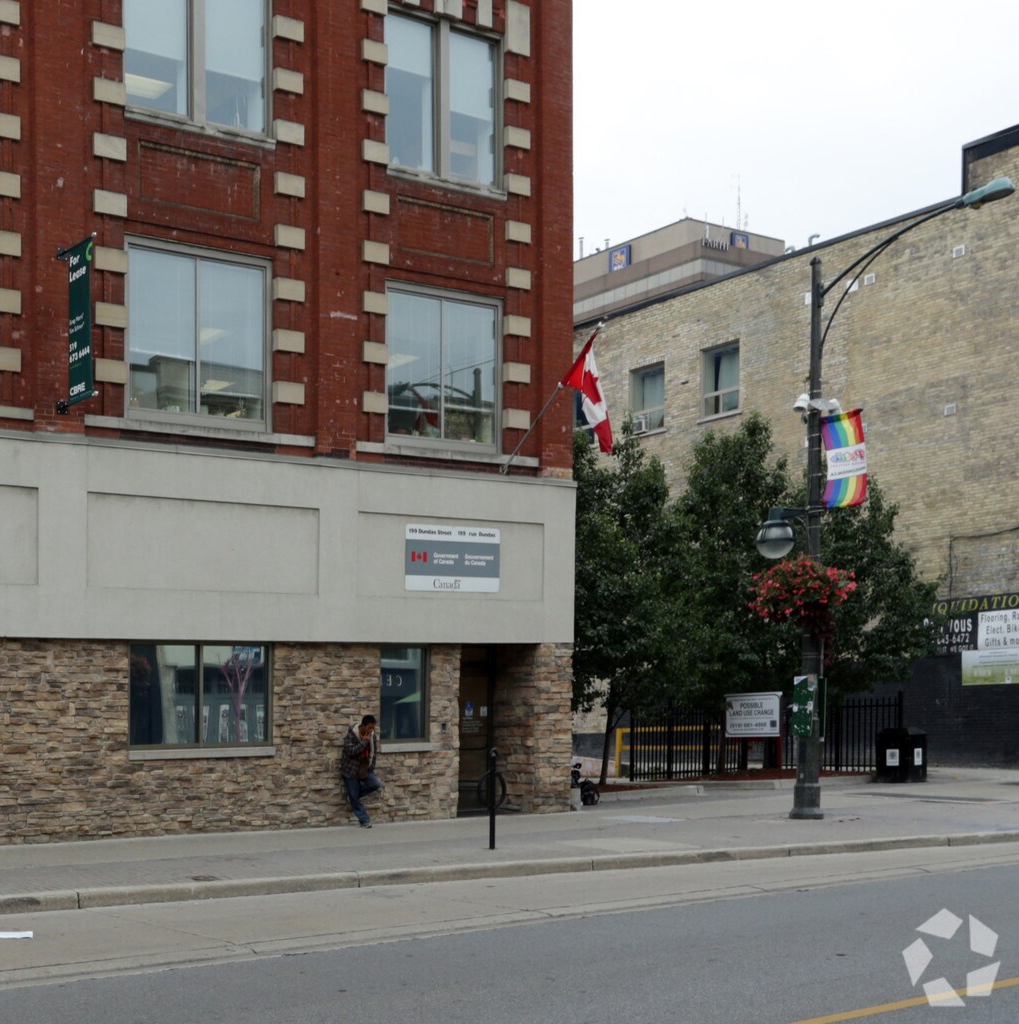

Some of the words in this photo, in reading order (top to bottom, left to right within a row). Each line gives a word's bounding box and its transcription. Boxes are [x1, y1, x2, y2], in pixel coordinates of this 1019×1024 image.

[69, 254, 81, 268] For
[69, 265, 87, 283] Lease
[69, 381, 86, 397] CBRE
[433, 578, 461, 590] Canada
[984, 638, 1001, 647] Gifts
[729, 709, 743, 717] LAND
